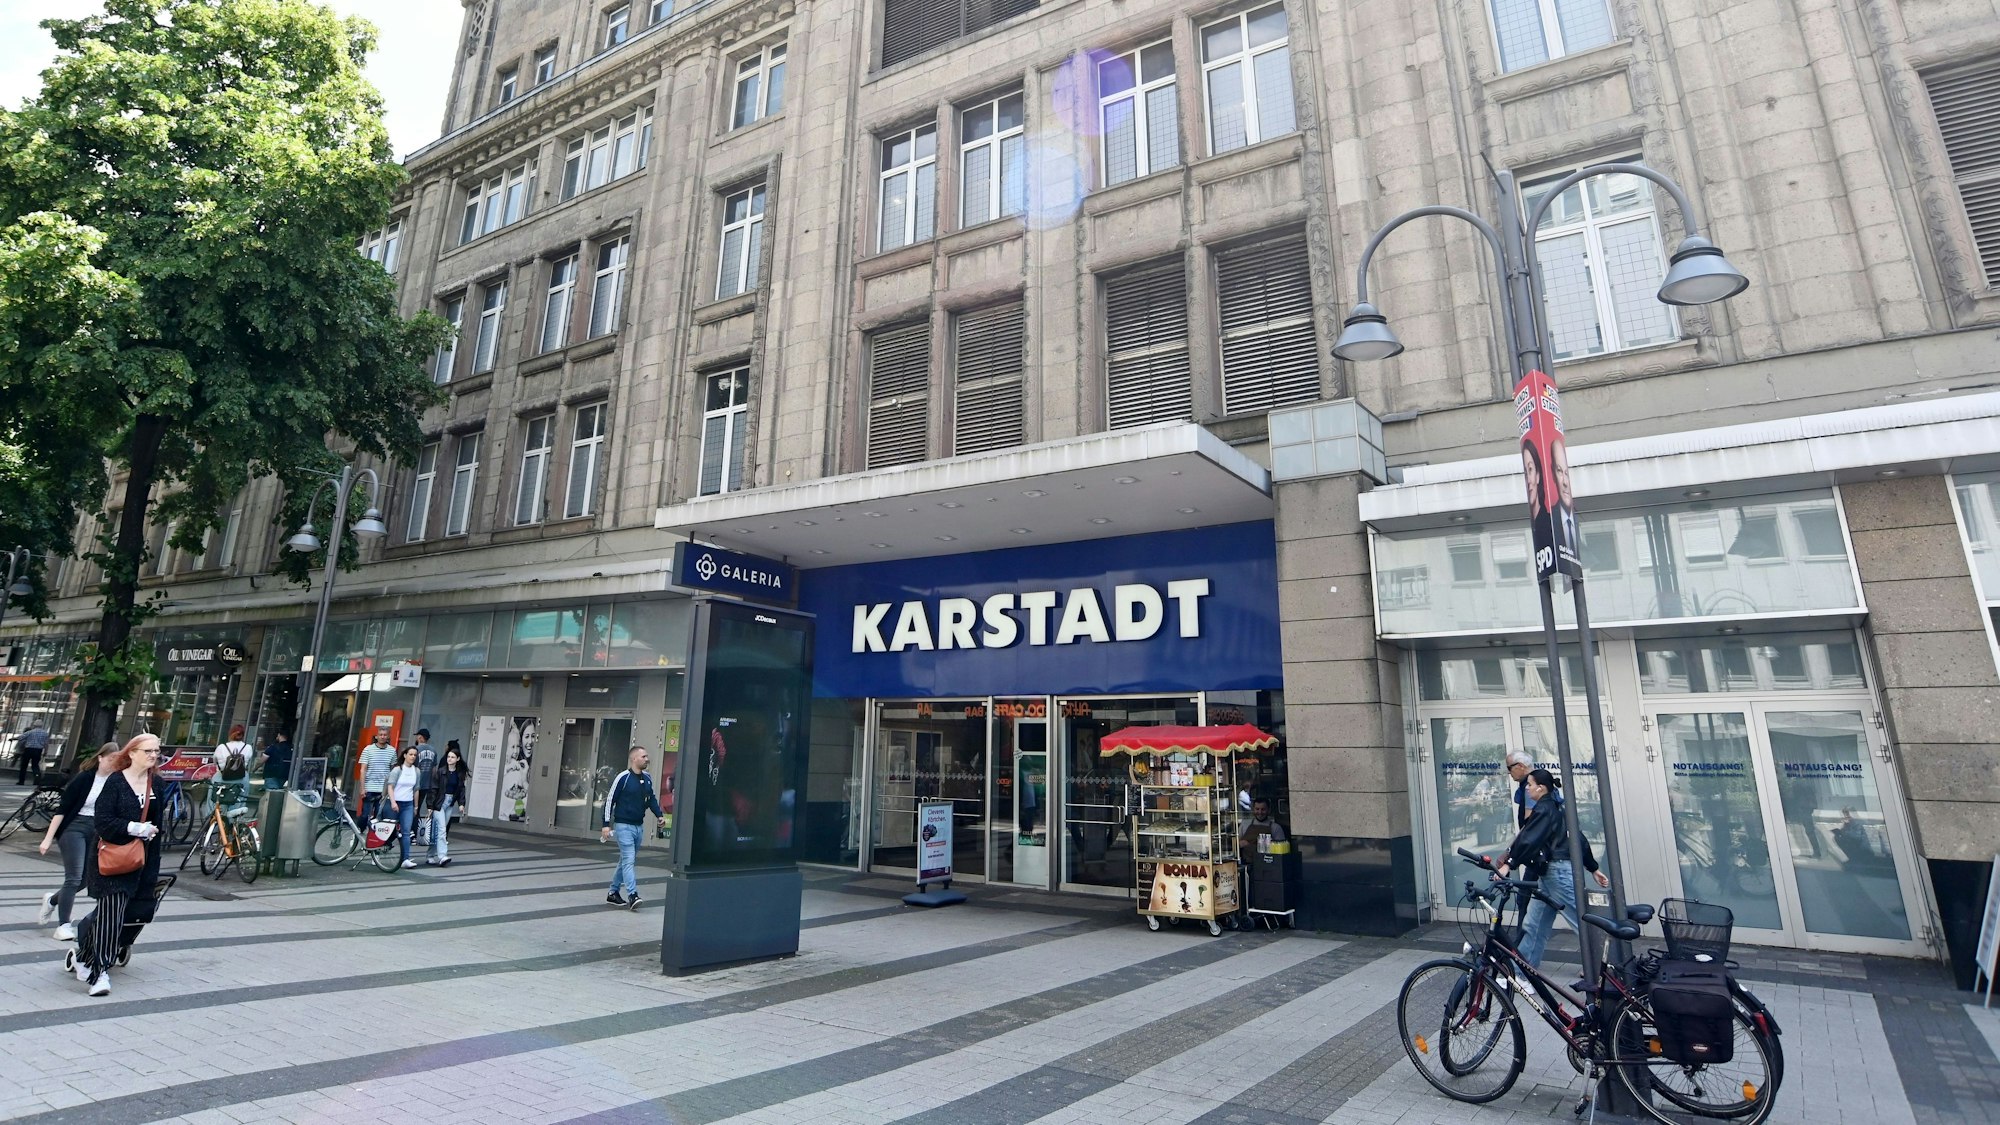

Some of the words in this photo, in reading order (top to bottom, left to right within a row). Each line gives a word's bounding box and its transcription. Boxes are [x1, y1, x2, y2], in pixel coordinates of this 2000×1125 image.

[1536, 546, 1553, 573] SPD
[721, 564, 781, 588] GALERIA
[852, 578, 1209, 653] KARSTADT
[168, 648, 179, 661] OIL
[181, 648, 213, 661] VINEGAR
[223, 647, 238, 657] OIL
[1784, 763, 1862, 771] NOTAUSGANG!
[1163, 863, 1208, 879] BOMBA
